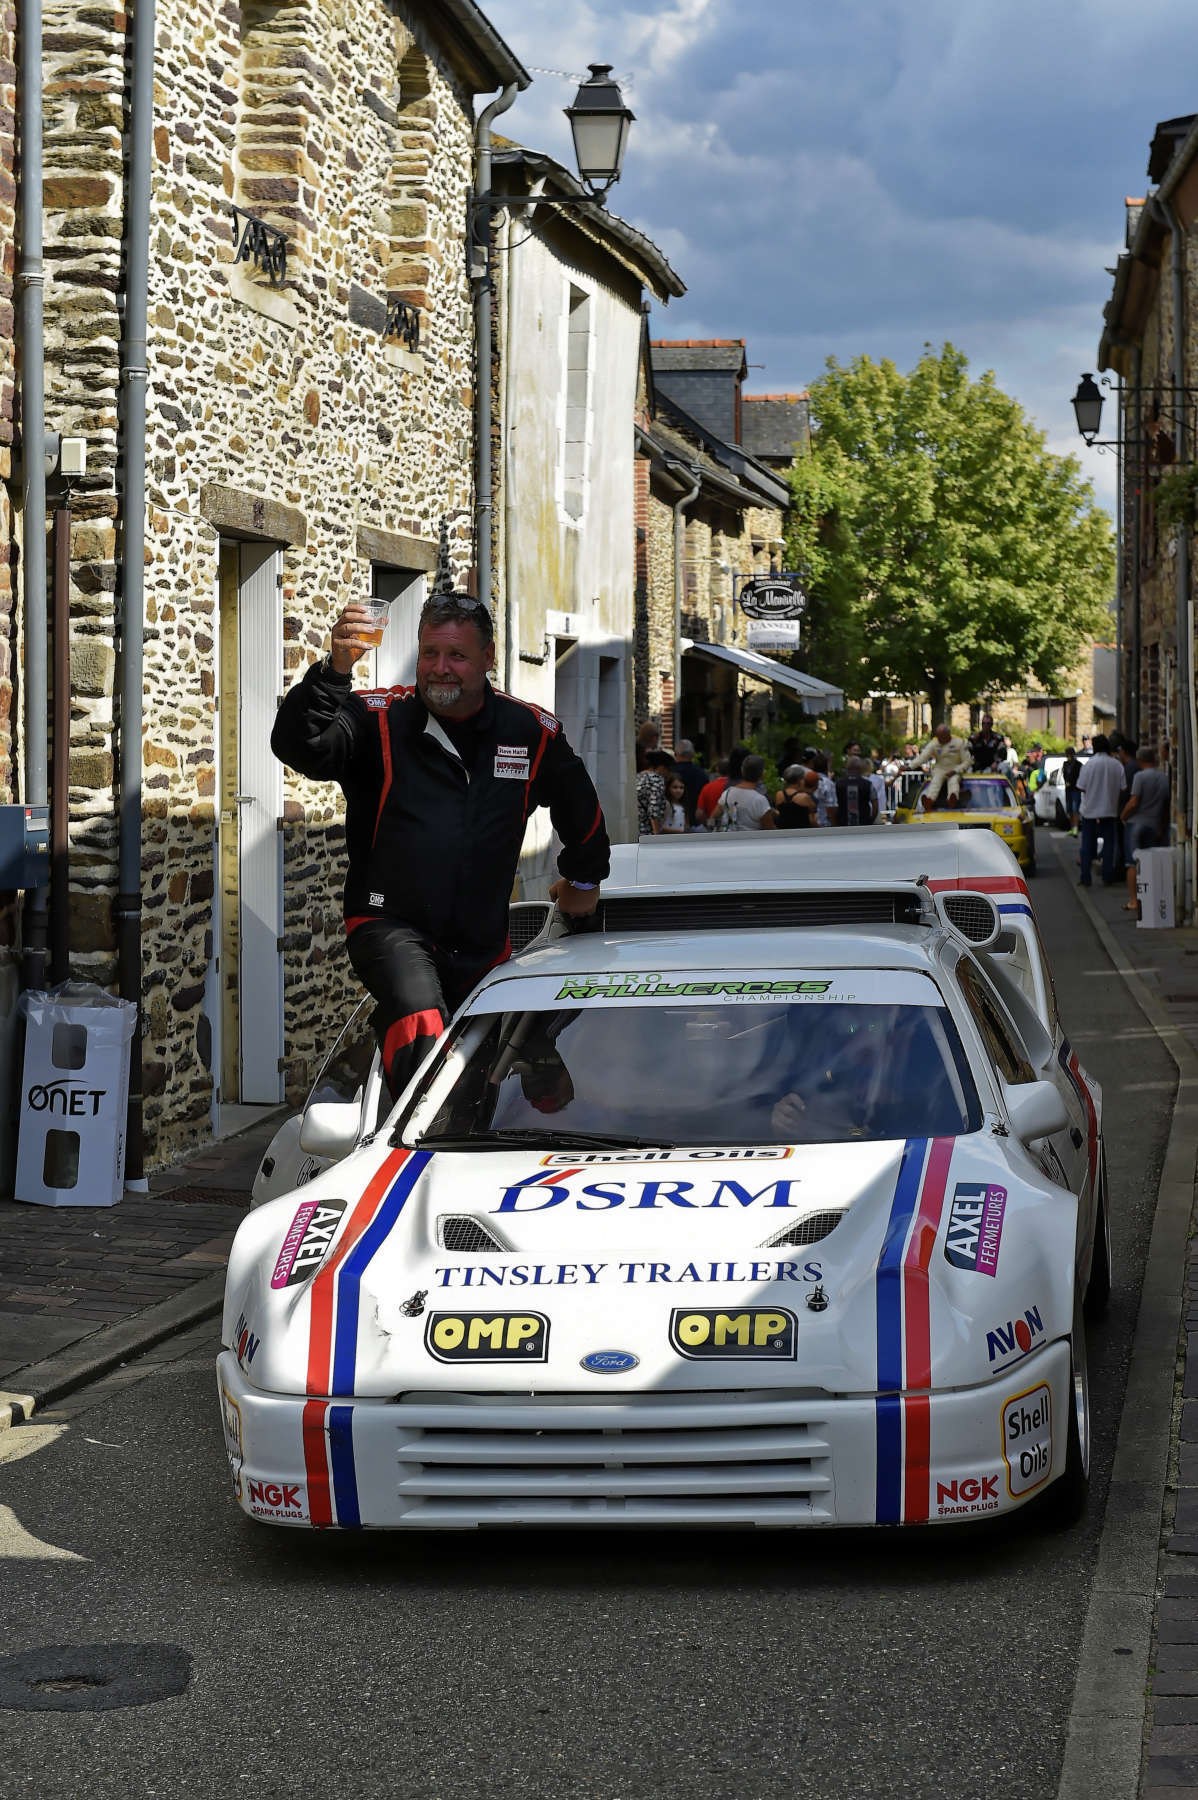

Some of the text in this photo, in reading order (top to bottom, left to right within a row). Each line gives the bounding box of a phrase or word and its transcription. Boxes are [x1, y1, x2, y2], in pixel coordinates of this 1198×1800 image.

[370, 894, 385, 905] OMP
[553, 981, 834, 1000] RALLYCROSS
[563, 973, 663, 986] RETRO
[723, 993, 857, 1002] CHAMPIONSHIP
[553, 1149, 779, 1163] Shell Oils
[488, 1179, 801, 1213] DSRM
[290, 1206, 343, 1275] AXEL
[945, 1191, 986, 1260] AXEL
[980, 1191, 1005, 1266] FERMETURES
[273, 1205, 314, 1281] FERMETURES
[435, 1261, 823, 1287] TINSLEY TRAILERS
[433, 1316, 541, 1350] OMP
[678, 1313, 788, 1347] OMP
[986, 1304, 1044, 1362] AVON
[591, 1354, 628, 1369] Ford
[1008, 1395, 1049, 1440] Shell
[1020, 1443, 1048, 1479] Oils
[249, 1482, 302, 1509] NGK
[936, 1474, 999, 1504] NGK
[253, 1506, 303, 1519] SPARK PLUGS
[938, 1501, 999, 1515] SPARK PLUGS
